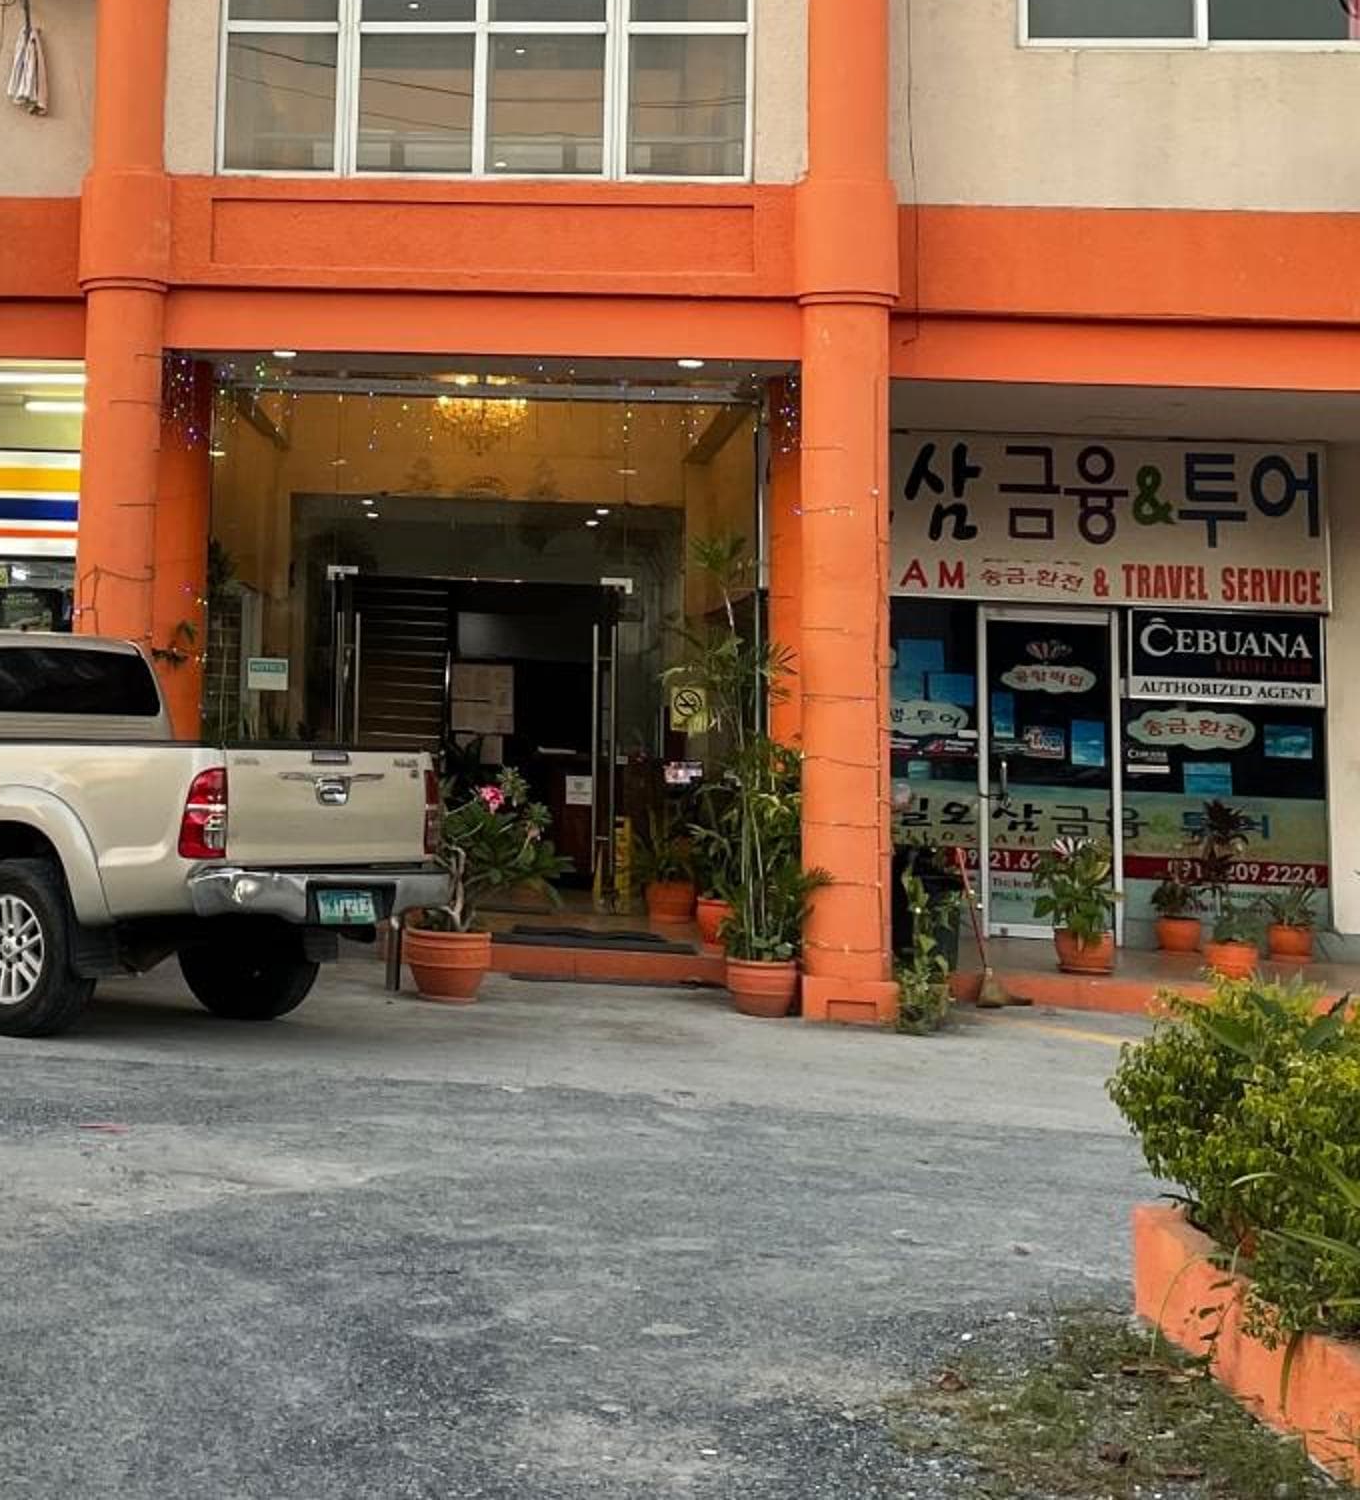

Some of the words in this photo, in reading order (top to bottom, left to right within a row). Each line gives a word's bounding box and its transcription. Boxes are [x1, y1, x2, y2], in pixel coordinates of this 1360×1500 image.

[1093, 567, 1110, 597] &
[1121, 563, 1209, 601] TRAVEL
[1221, 566, 1323, 606] SERVICE
[1139, 617, 1313, 659] CEBUANA
[1139, 680, 1253, 697] AUTHORIZED
[1257, 684, 1315, 700] AGENT
